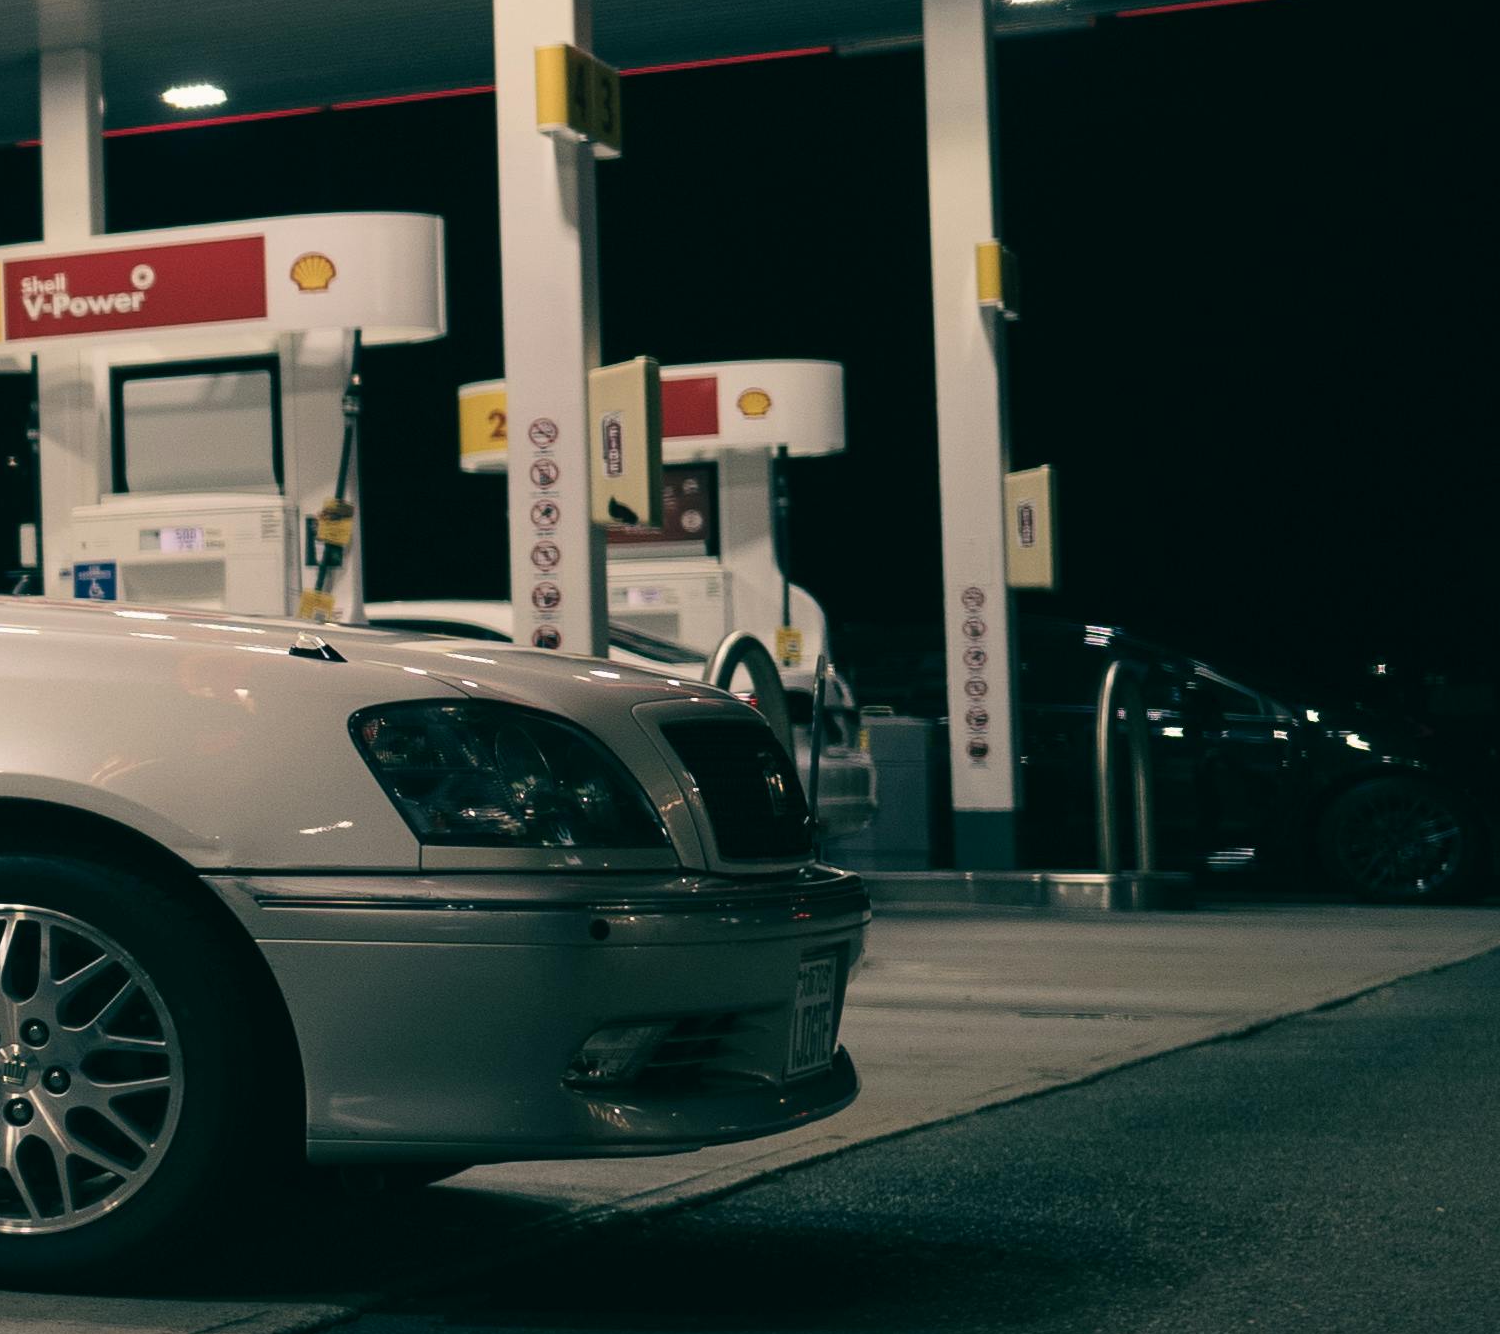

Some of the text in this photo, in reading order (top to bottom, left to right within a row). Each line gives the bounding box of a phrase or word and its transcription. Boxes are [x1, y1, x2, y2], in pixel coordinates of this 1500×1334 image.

[21, 273, 67, 295] Shell
[22, 291, 146, 322] V-Power
[488, 408, 507, 440] 2
[609, 425, 620, 473] FIRE
